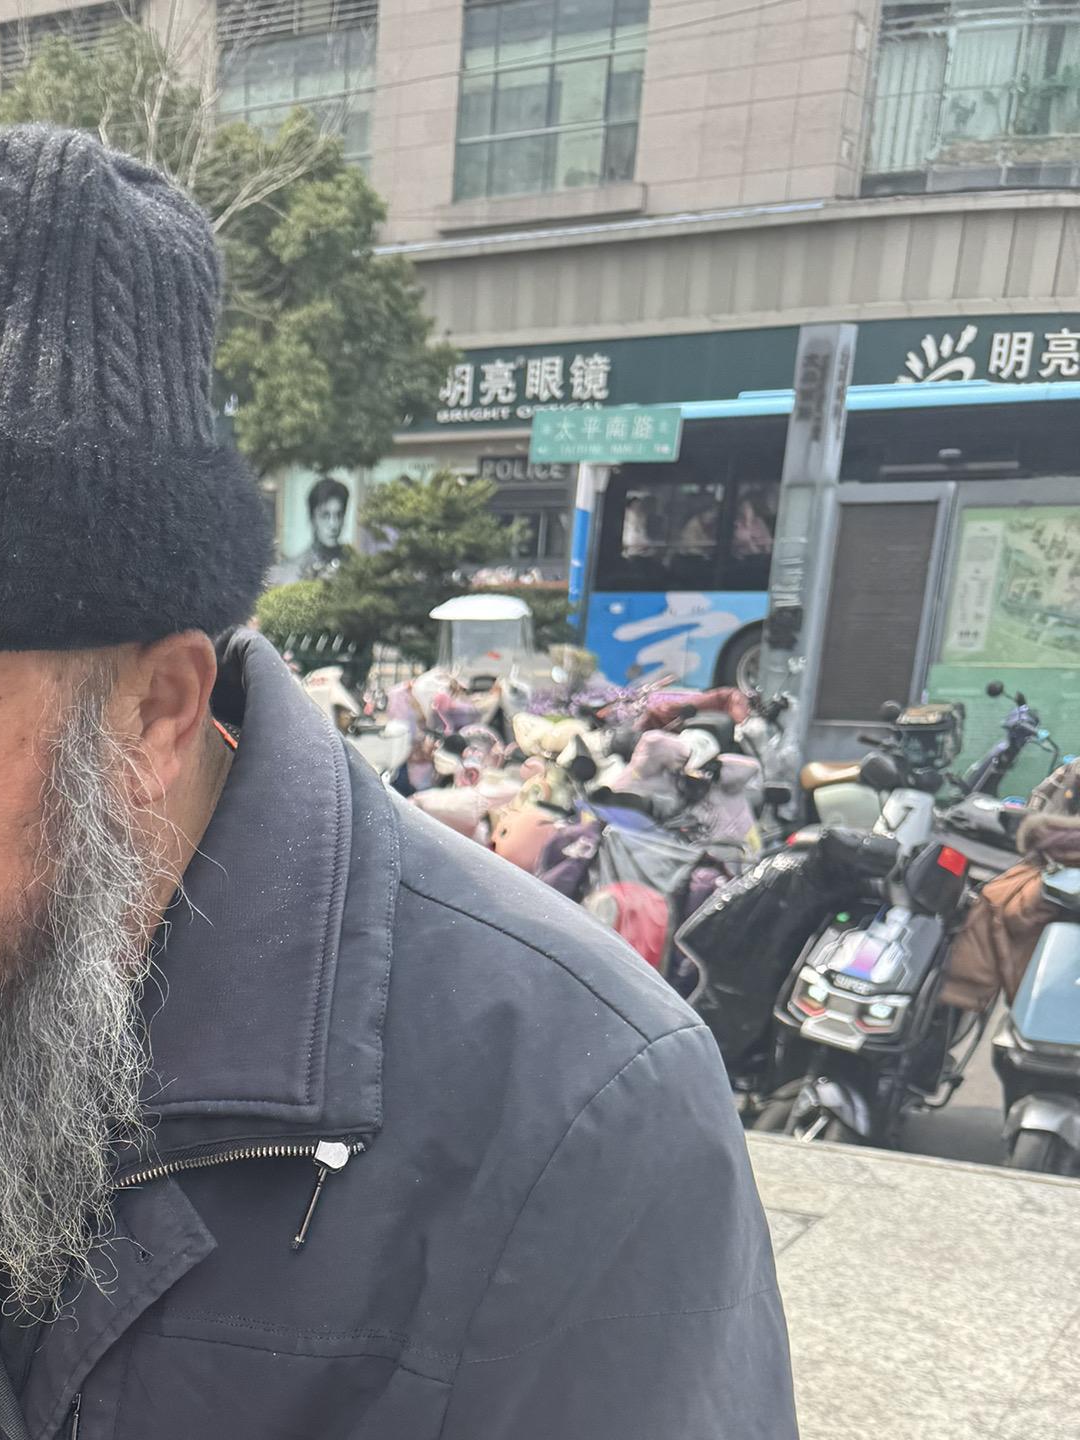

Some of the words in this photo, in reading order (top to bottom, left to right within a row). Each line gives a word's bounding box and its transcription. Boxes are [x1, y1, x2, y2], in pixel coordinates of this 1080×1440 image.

[439, 352, 611, 407] 明亮眼镜
[988, 328, 1080, 380] 明亮
[481, 460, 567, 482] POLICE
